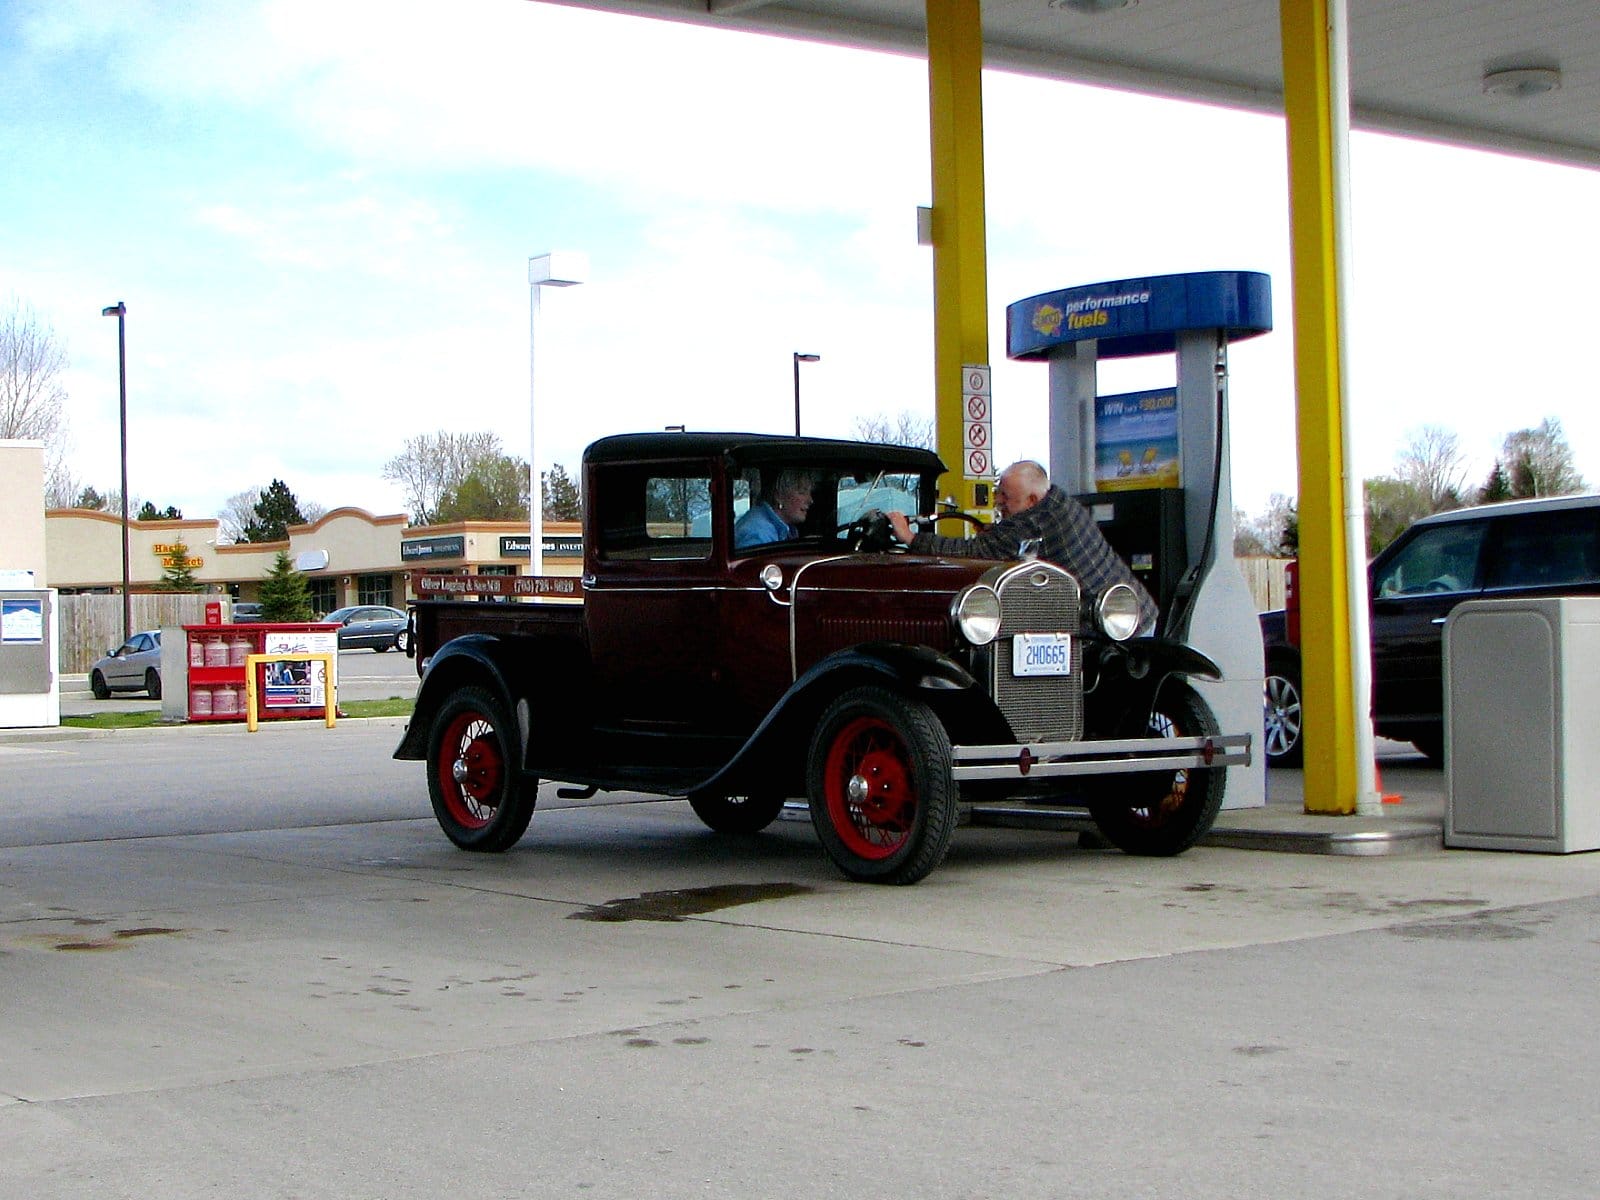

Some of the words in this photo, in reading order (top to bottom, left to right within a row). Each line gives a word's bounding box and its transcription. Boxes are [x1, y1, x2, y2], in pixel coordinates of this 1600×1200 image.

[1065, 292, 1150, 316] performance
[1067, 309, 1109, 330] fuels
[505, 540, 532, 551] Edwar
